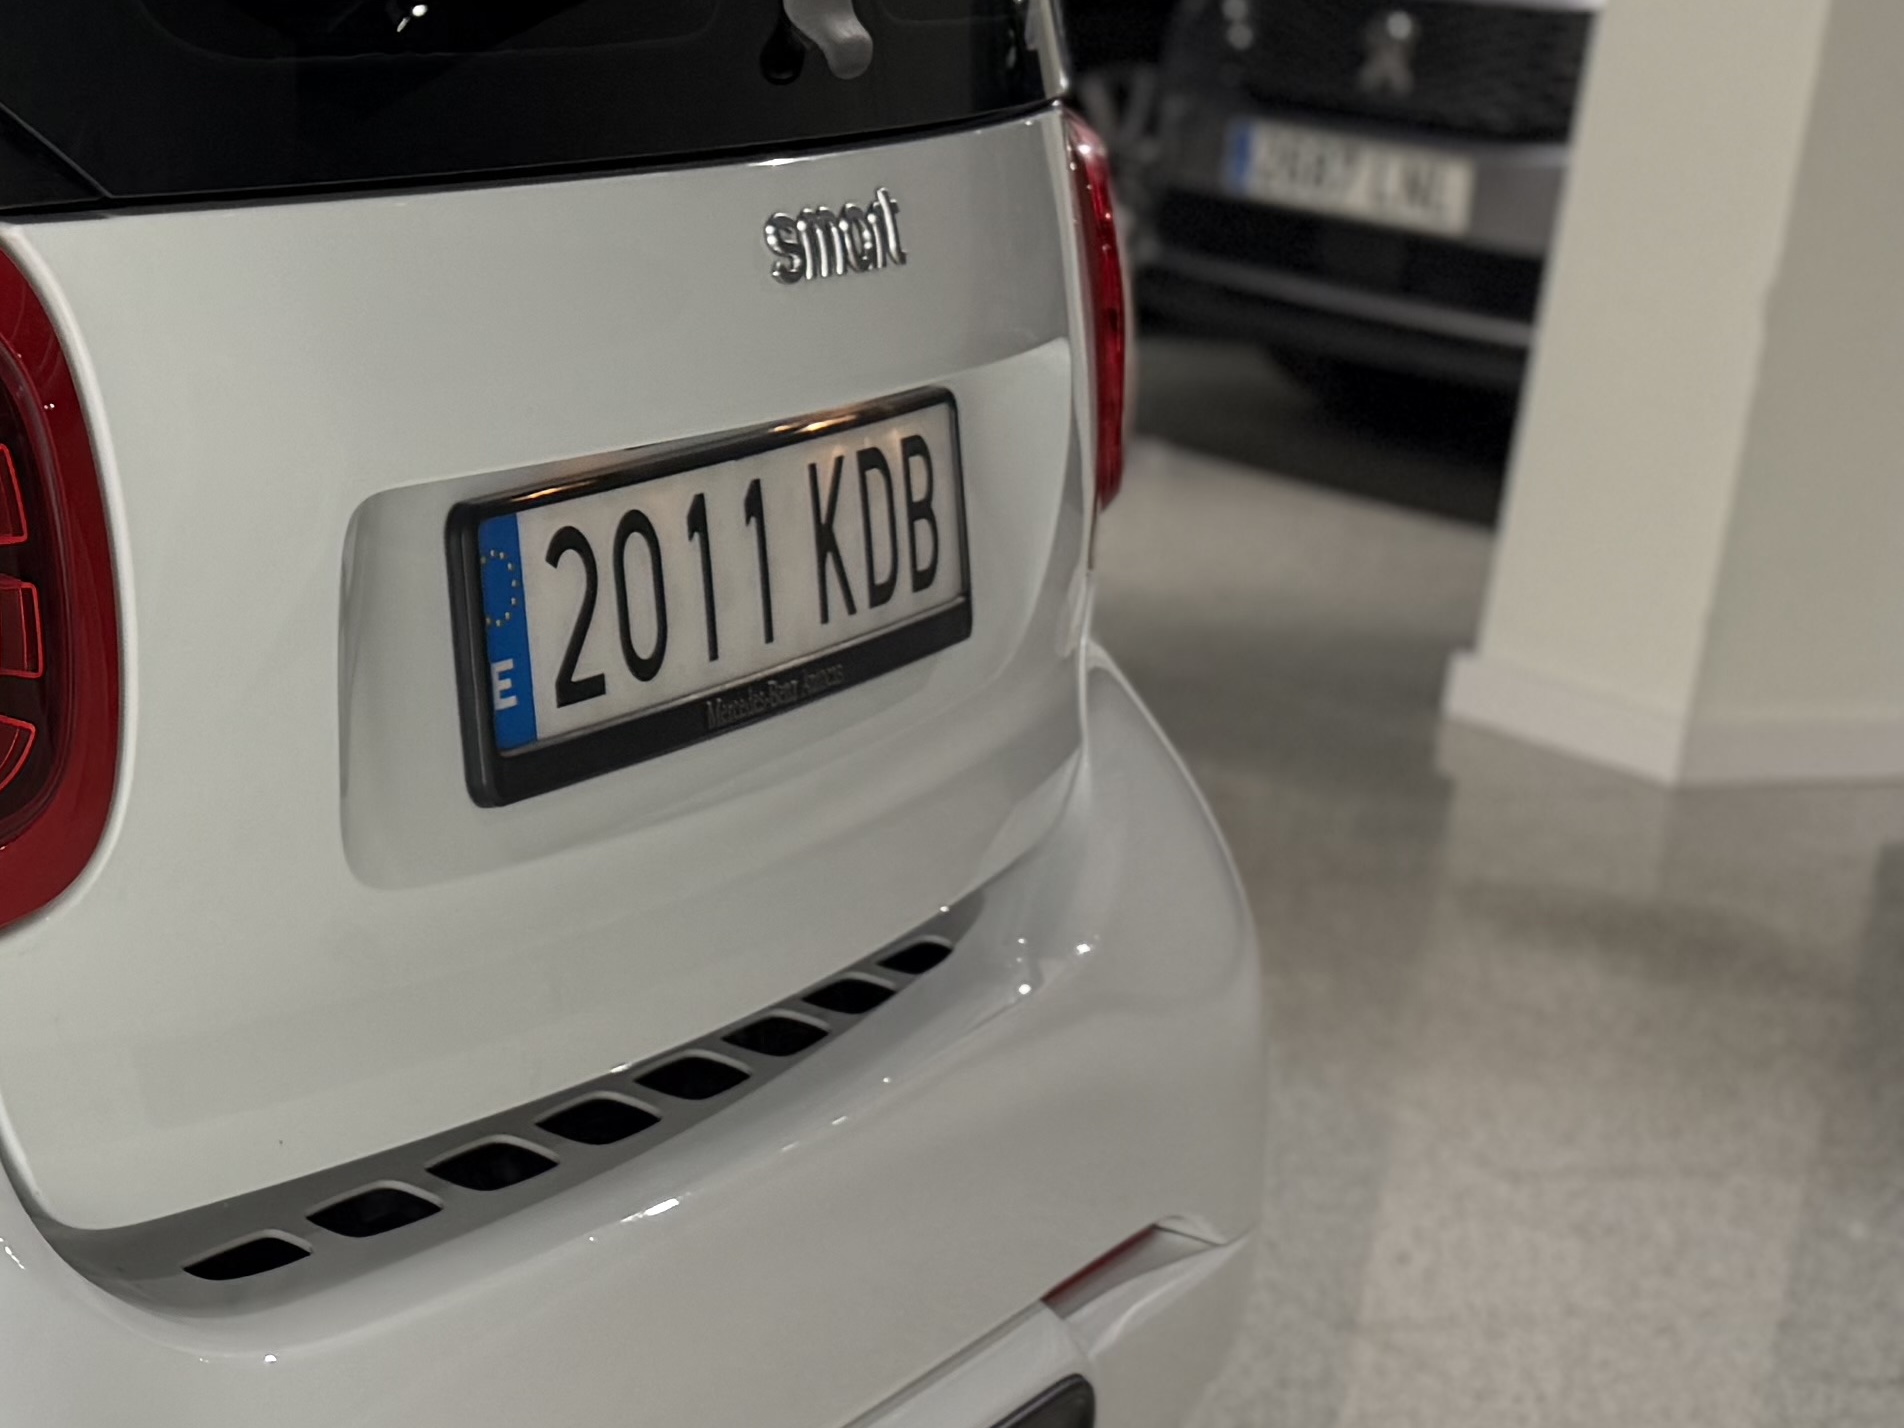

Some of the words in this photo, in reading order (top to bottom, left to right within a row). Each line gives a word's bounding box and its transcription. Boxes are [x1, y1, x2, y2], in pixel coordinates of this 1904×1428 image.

[764, 187, 906, 284] smart
[545, 478, 774, 708] 2011
[808, 434, 939, 625] KDB
[492, 659, 517, 710] E
